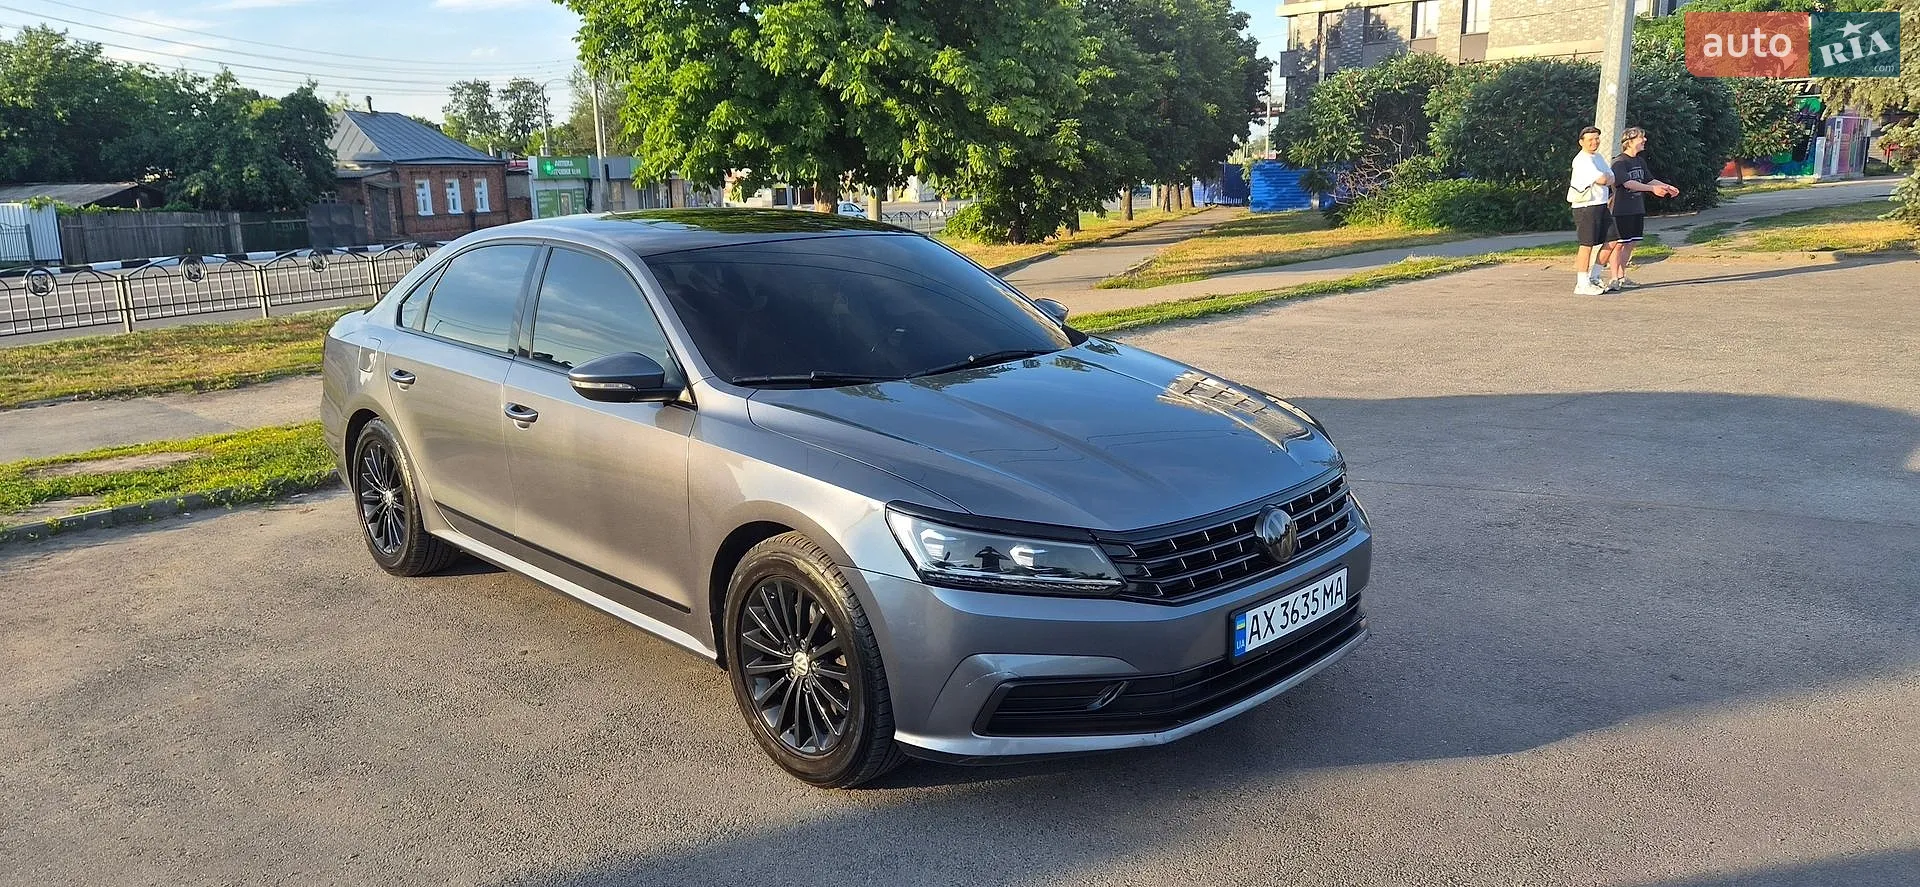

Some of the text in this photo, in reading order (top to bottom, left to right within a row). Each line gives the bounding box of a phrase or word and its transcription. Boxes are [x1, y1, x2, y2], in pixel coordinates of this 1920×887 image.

[1248, 576, 1343, 645] AX 3635 MA
[1236, 640, 1246, 650] UA
